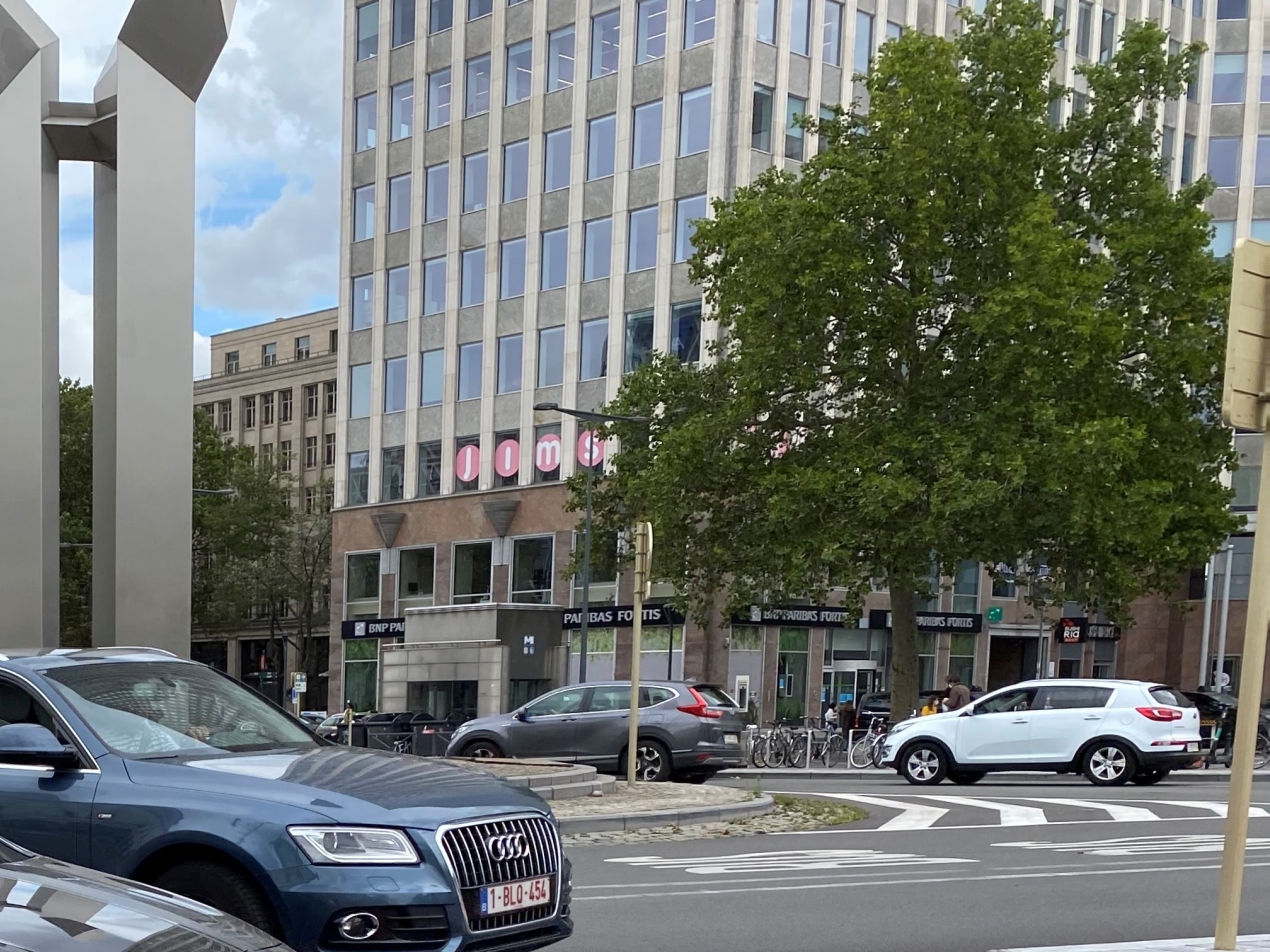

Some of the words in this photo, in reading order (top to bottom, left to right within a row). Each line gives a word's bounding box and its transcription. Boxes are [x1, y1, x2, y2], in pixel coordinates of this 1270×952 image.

[617, 609, 662, 622] FOTIS
[368, 623, 389, 633] BNP
[947, 617, 974, 628] FORTIS
